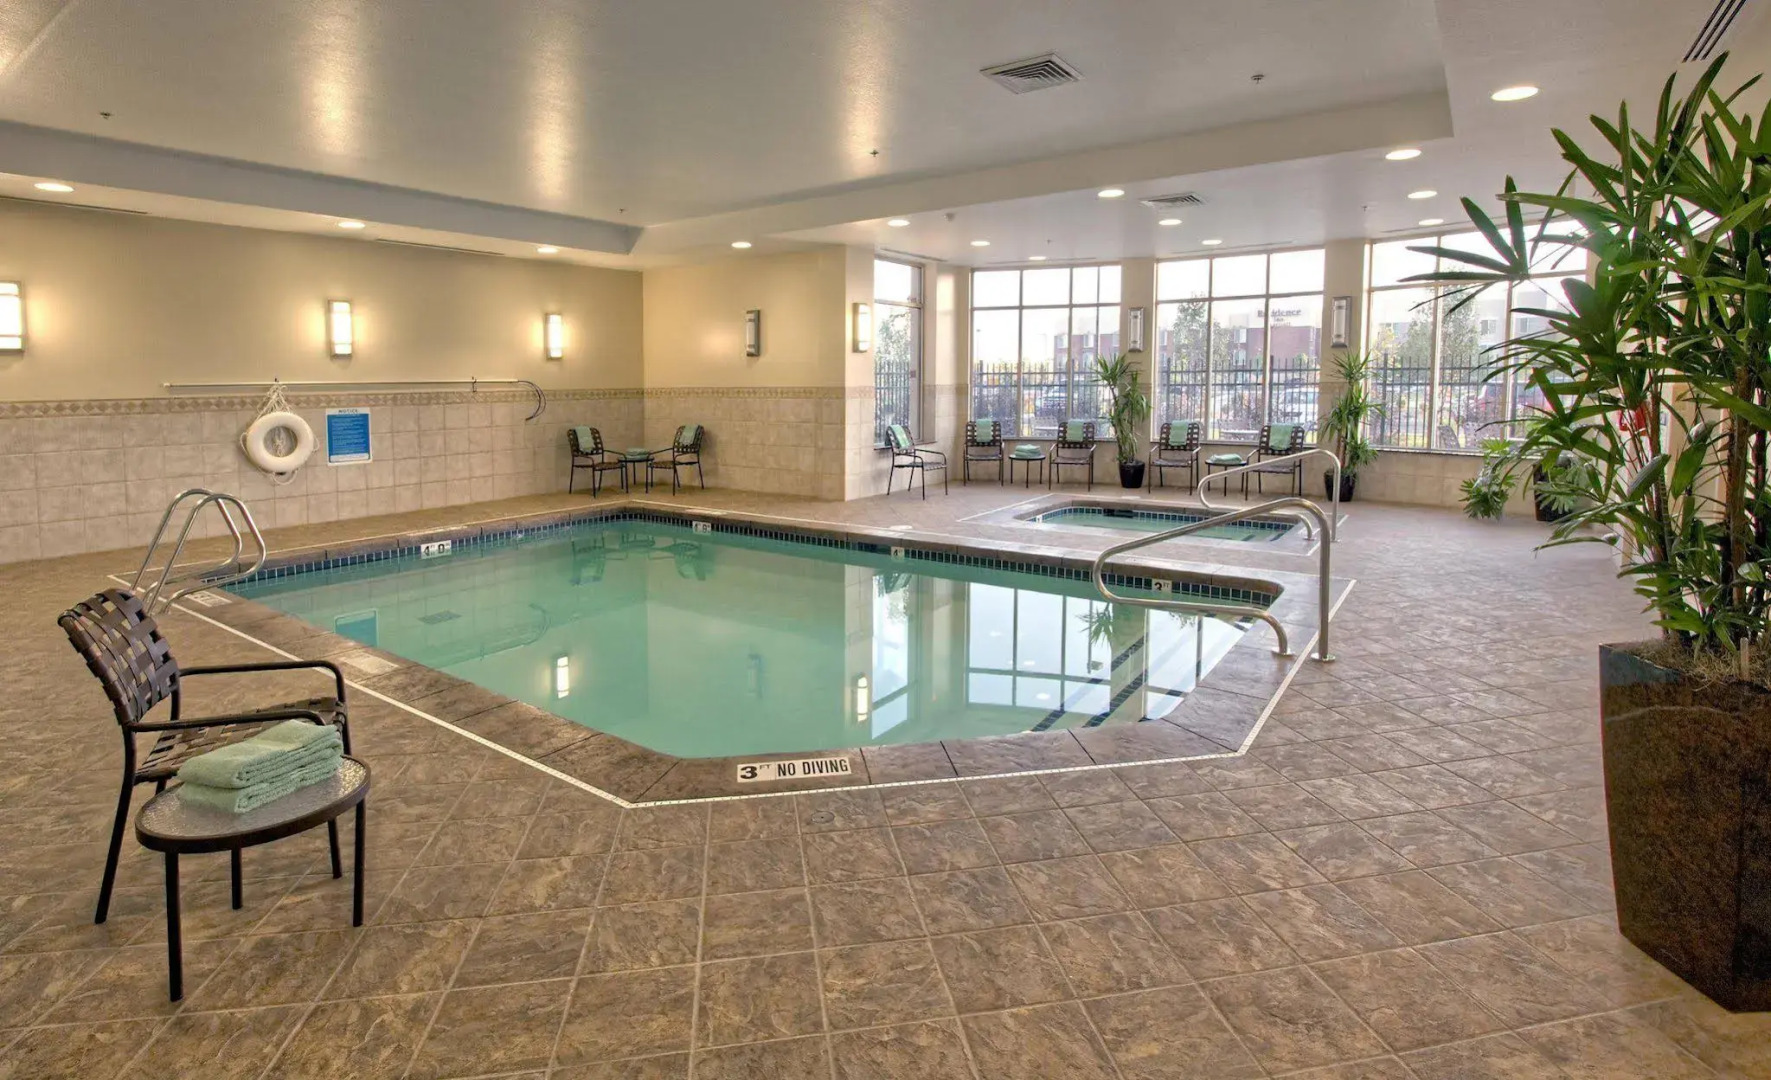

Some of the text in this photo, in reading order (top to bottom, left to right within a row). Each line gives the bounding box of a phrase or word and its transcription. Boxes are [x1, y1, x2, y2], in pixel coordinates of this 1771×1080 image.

[1257, 309, 1302, 317] Ridence
[777, 762, 796, 777] NO
[802, 759, 849, 775] DIVING
